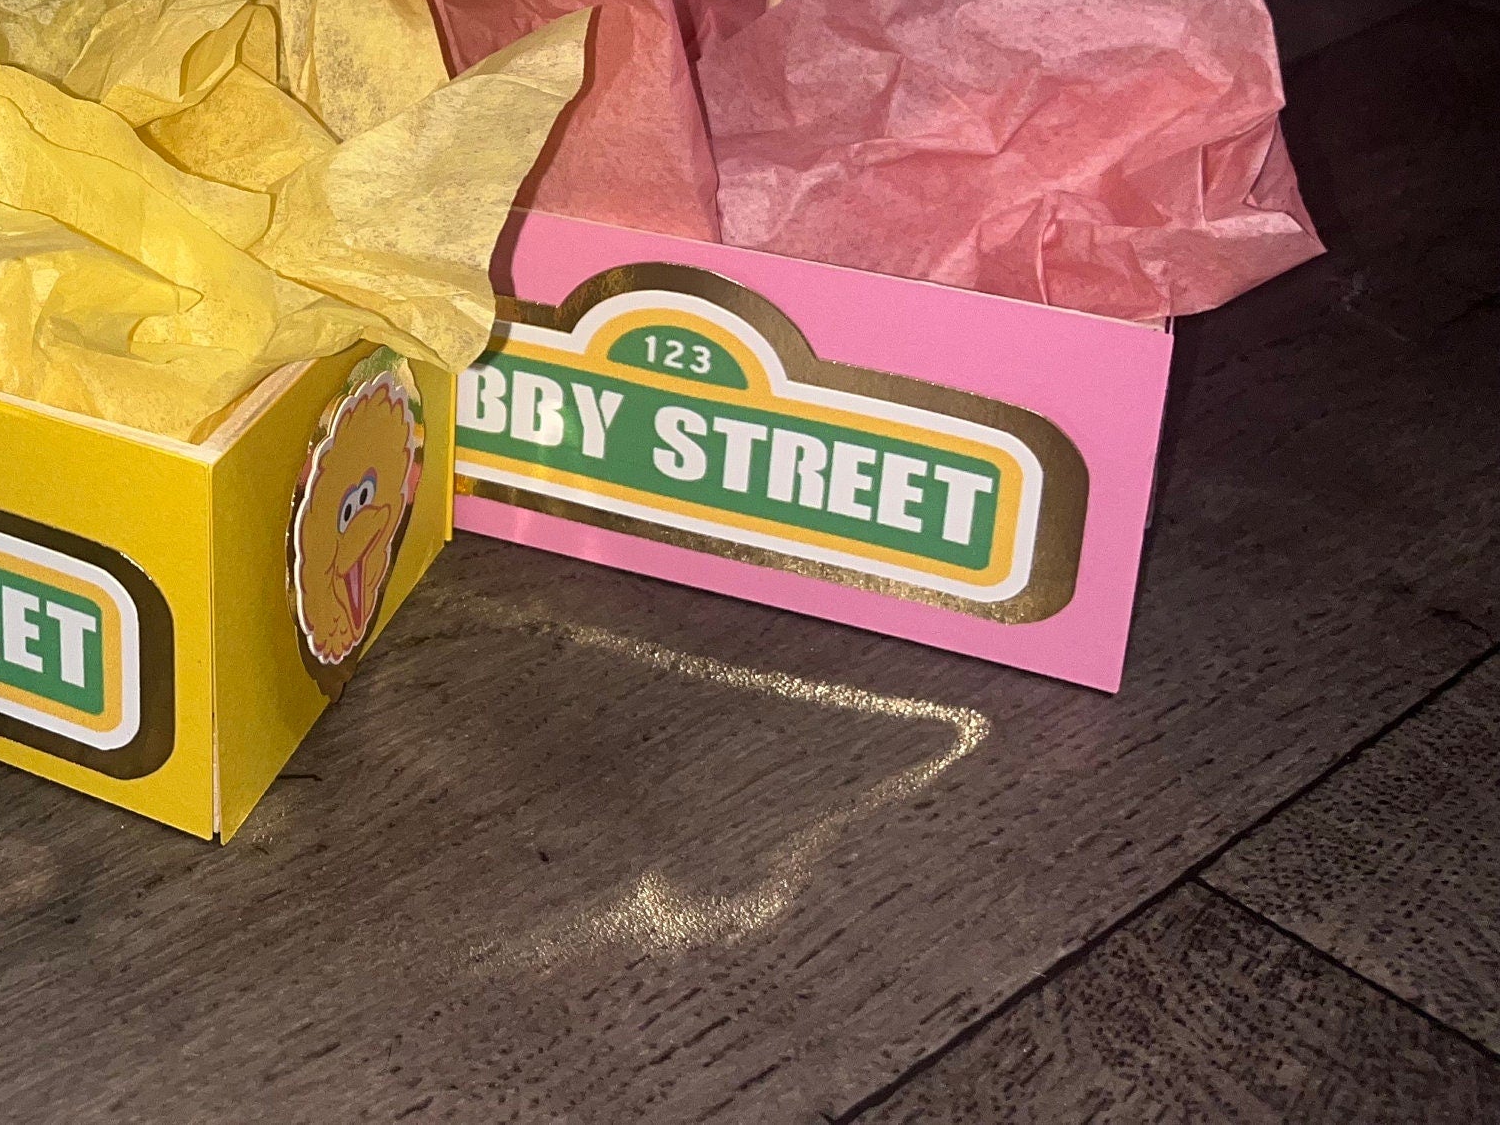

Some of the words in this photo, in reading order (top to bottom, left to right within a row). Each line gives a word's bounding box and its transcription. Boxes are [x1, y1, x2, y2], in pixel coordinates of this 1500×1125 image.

[645, 335, 713, 375] 123
[456, 363, 627, 460] BBY
[652, 405, 995, 546] STREET
